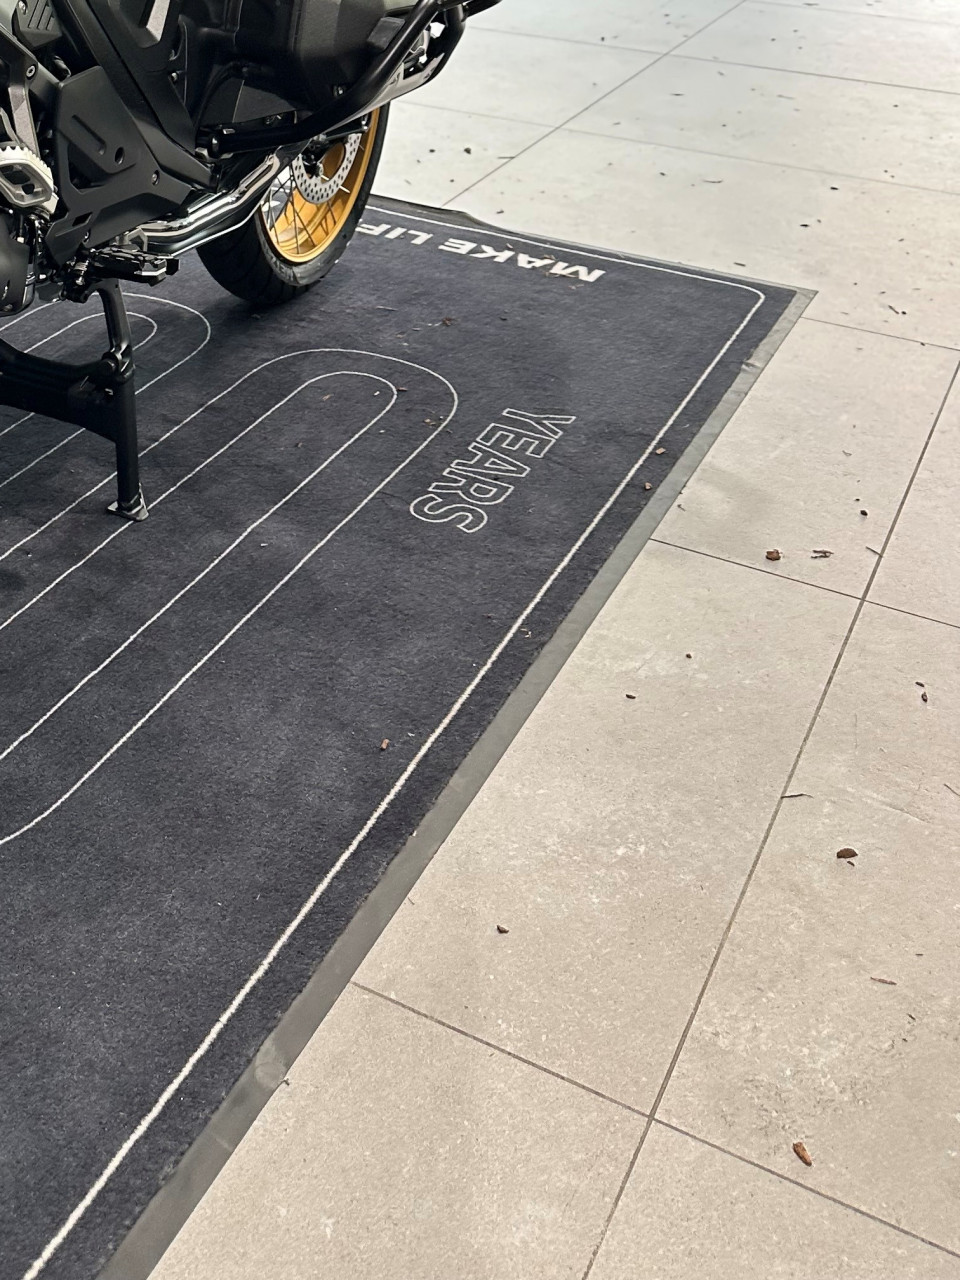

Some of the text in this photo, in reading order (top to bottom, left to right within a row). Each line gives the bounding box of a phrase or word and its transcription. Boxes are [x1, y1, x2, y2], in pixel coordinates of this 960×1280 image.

[355, 218, 606, 283] MAKE LIF
[409, 407, 577, 534] YEARS
